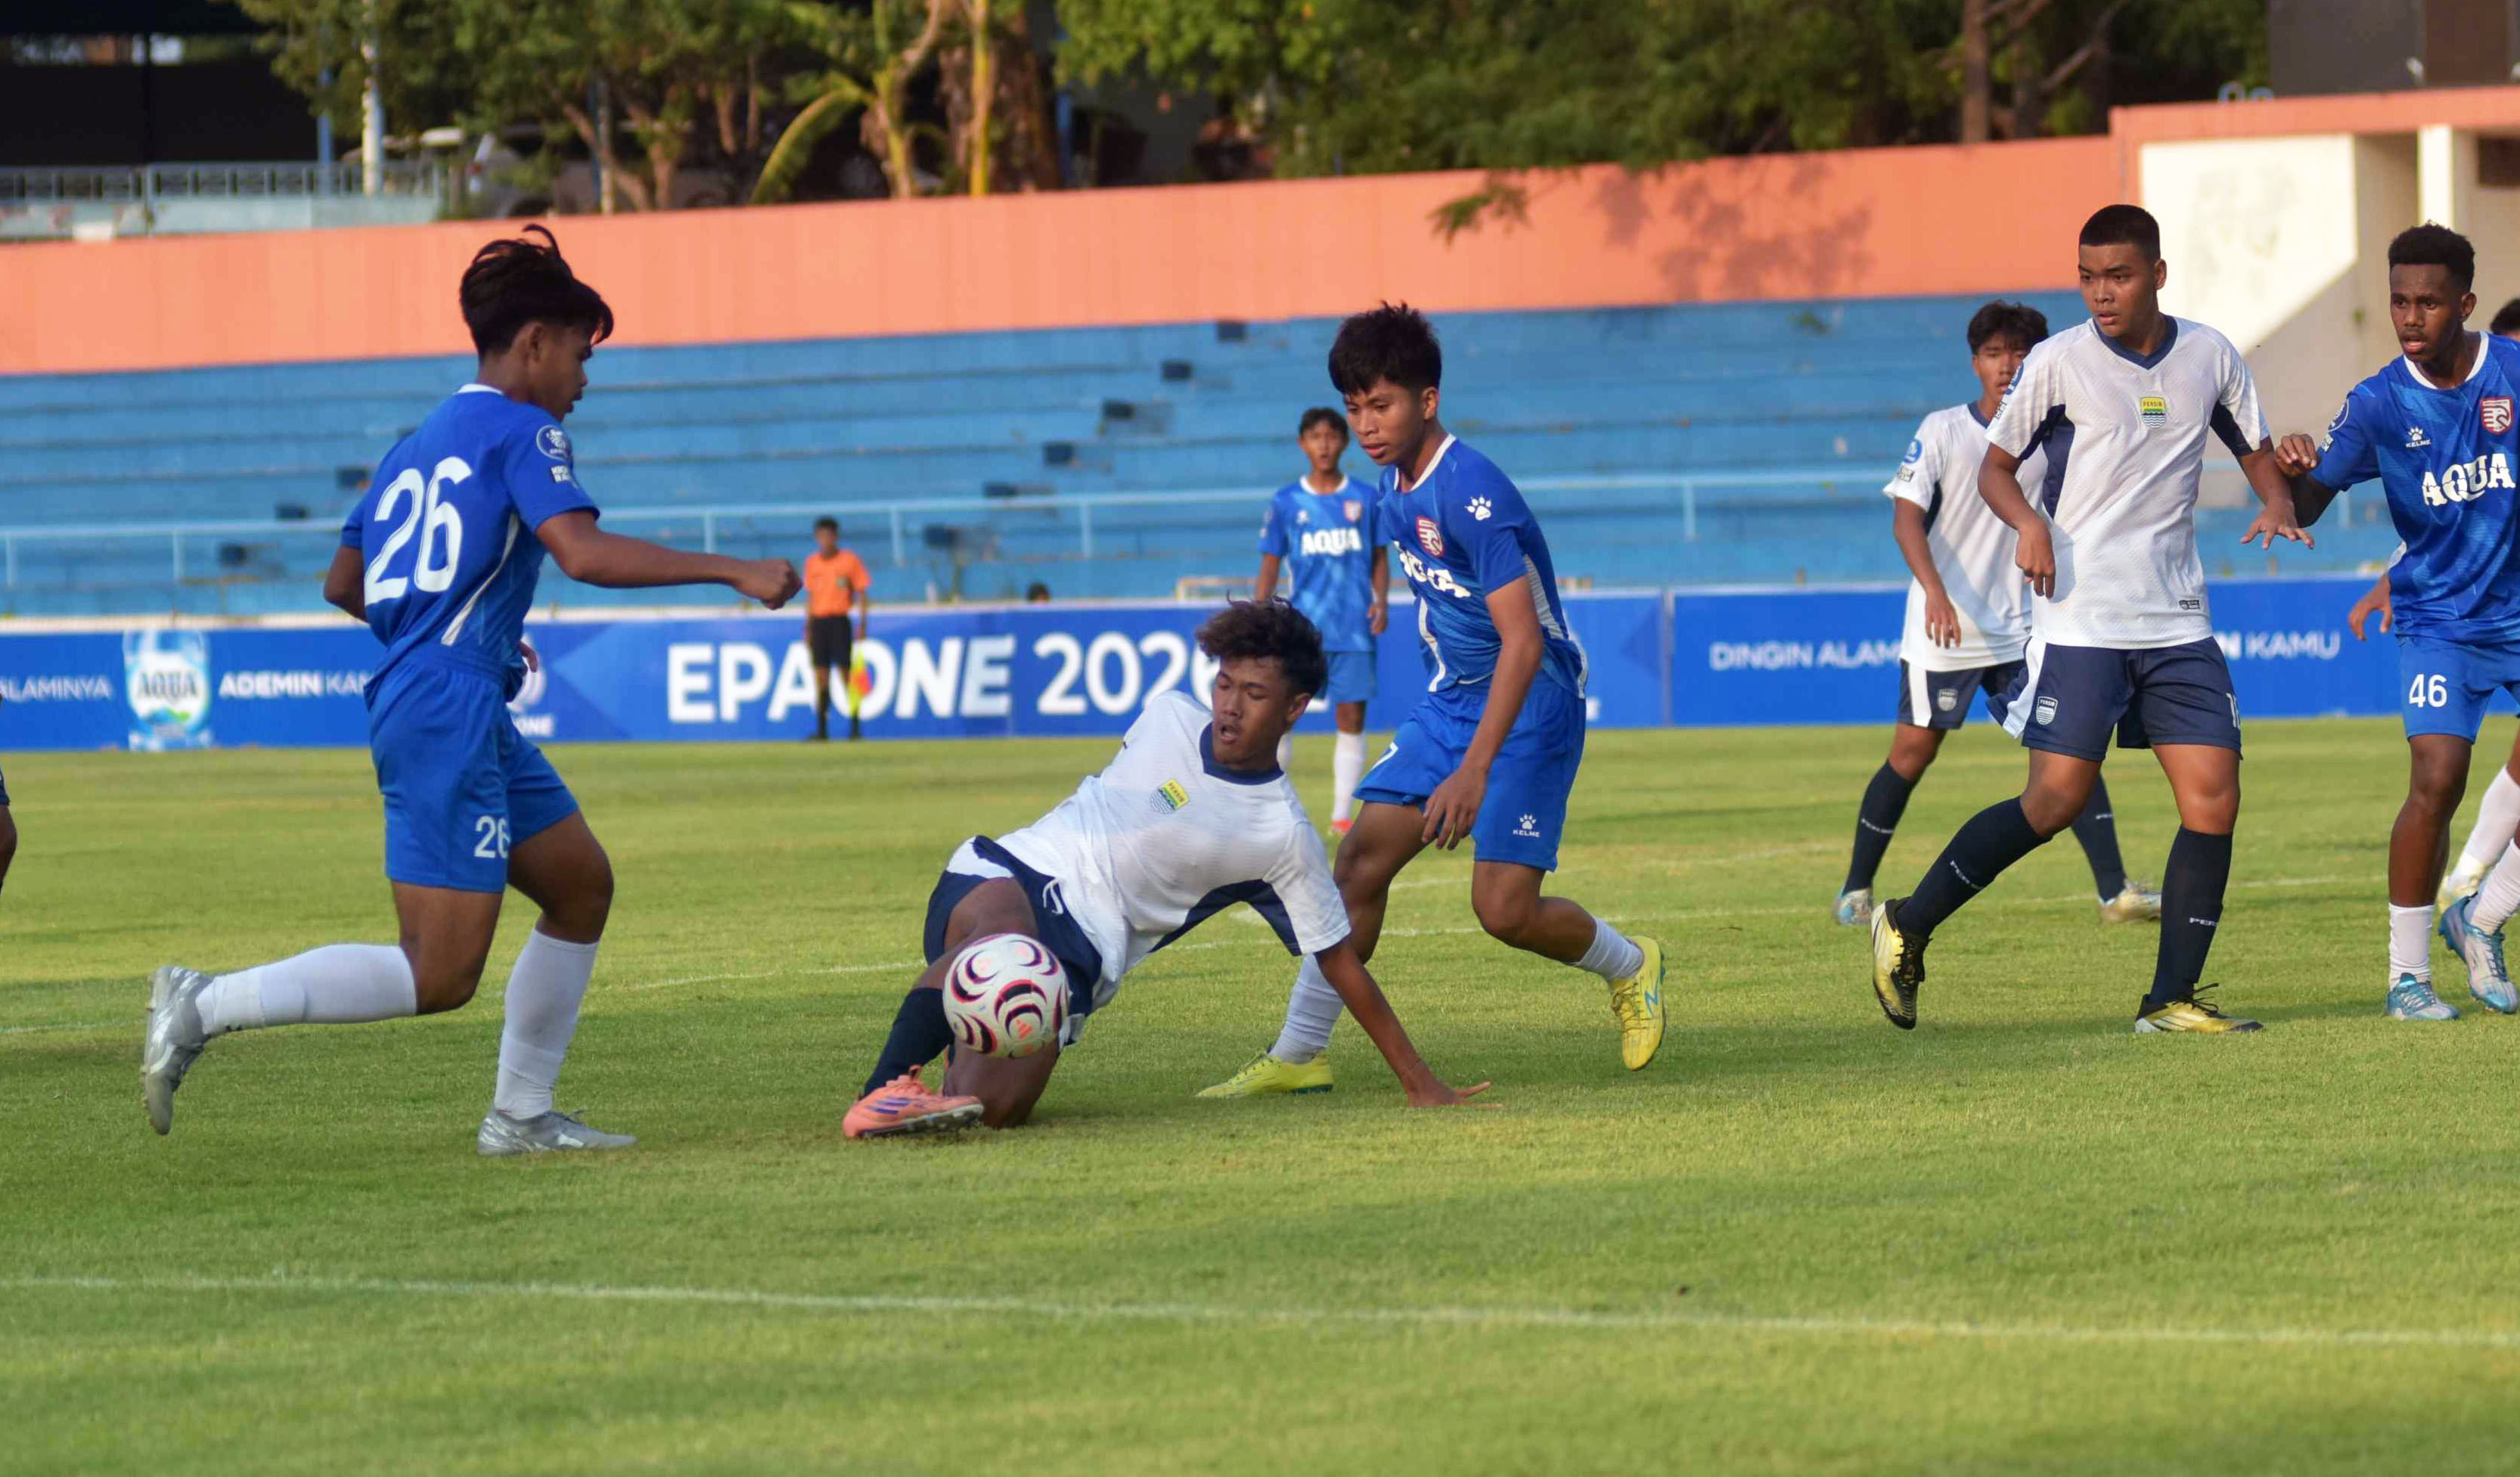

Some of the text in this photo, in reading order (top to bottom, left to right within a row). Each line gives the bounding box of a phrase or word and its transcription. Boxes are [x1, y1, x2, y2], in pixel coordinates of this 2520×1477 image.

[2422, 453, 2516, 506] AQUA
[365, 456, 473, 606] 26
[1301, 527, 1362, 557] AQUA
[1710, 641, 1814, 670] DINGIN
[2245, 630, 2342, 660] KAMU
[218, 669, 324, 698] ADEMIN
[2408, 673, 2448, 709] 46
[473, 815, 512, 860] 26
